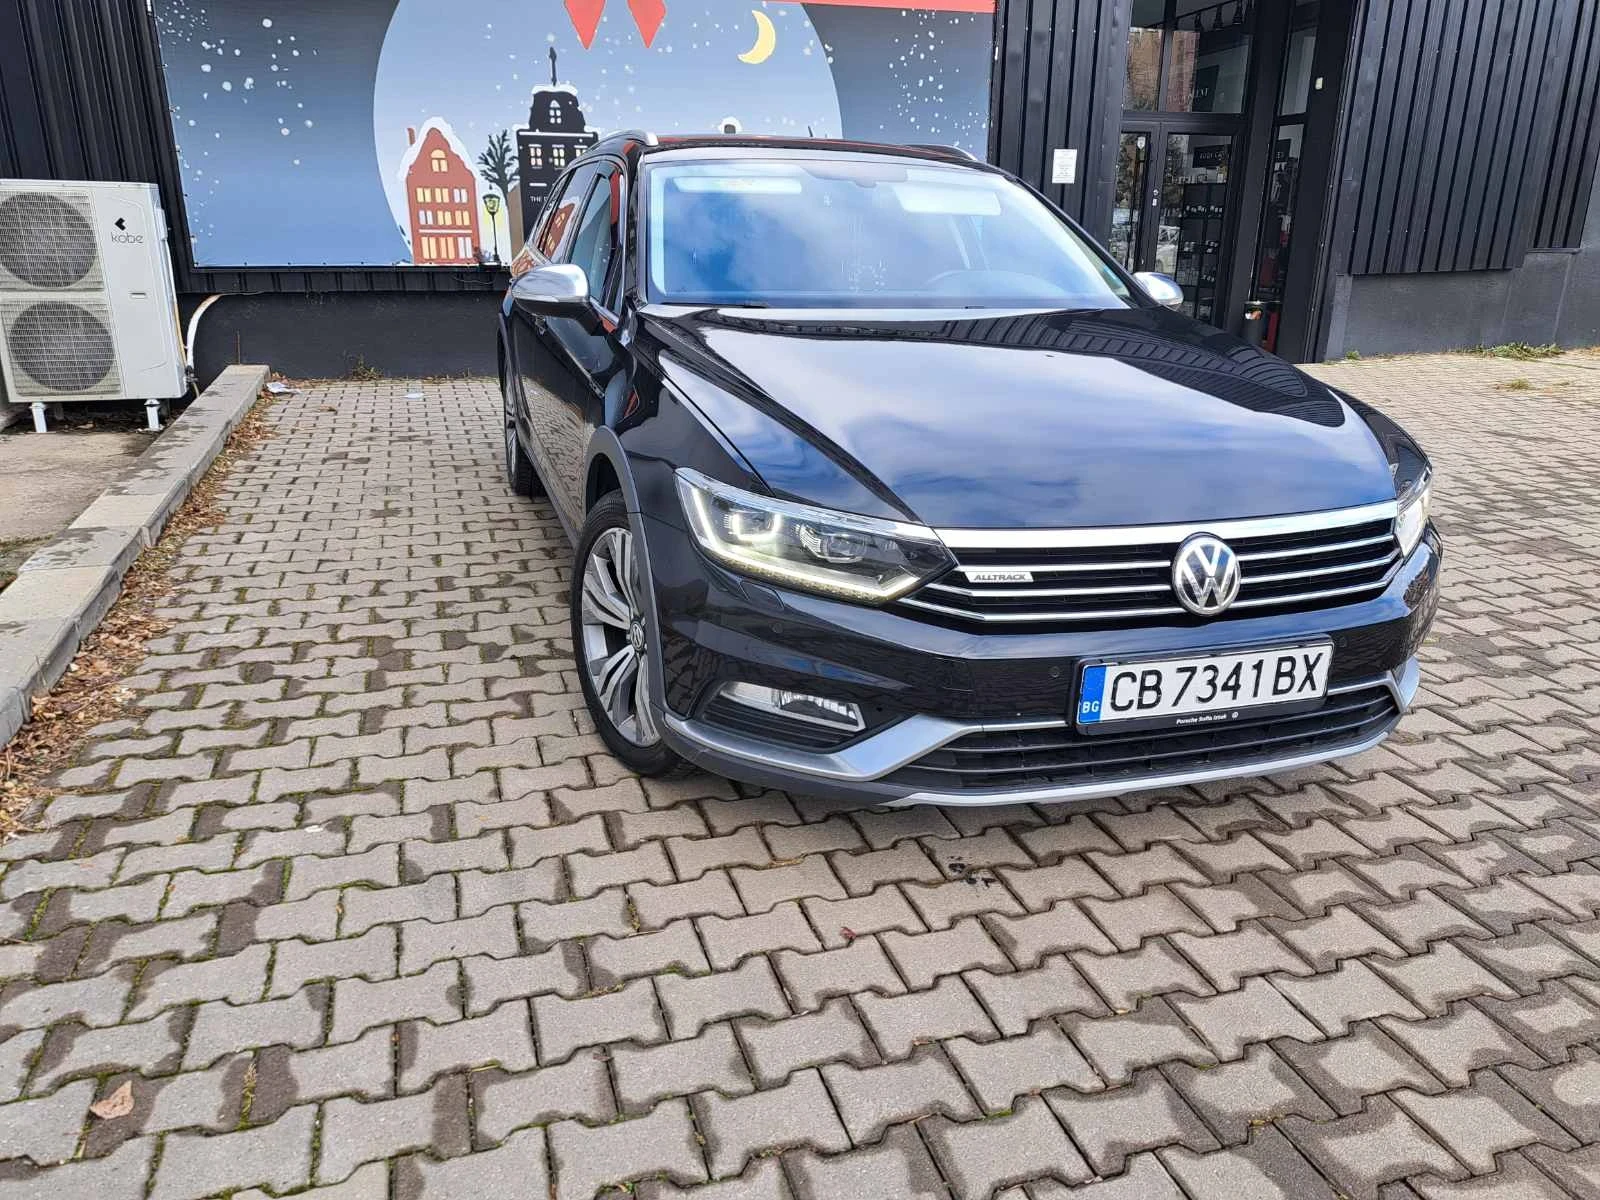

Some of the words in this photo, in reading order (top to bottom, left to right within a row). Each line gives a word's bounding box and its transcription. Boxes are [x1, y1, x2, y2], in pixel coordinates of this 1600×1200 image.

[111, 232, 143, 243] kobe
[973, 573, 1026, 581] ALLTRACK
[1082, 701, 1099, 714] BG
